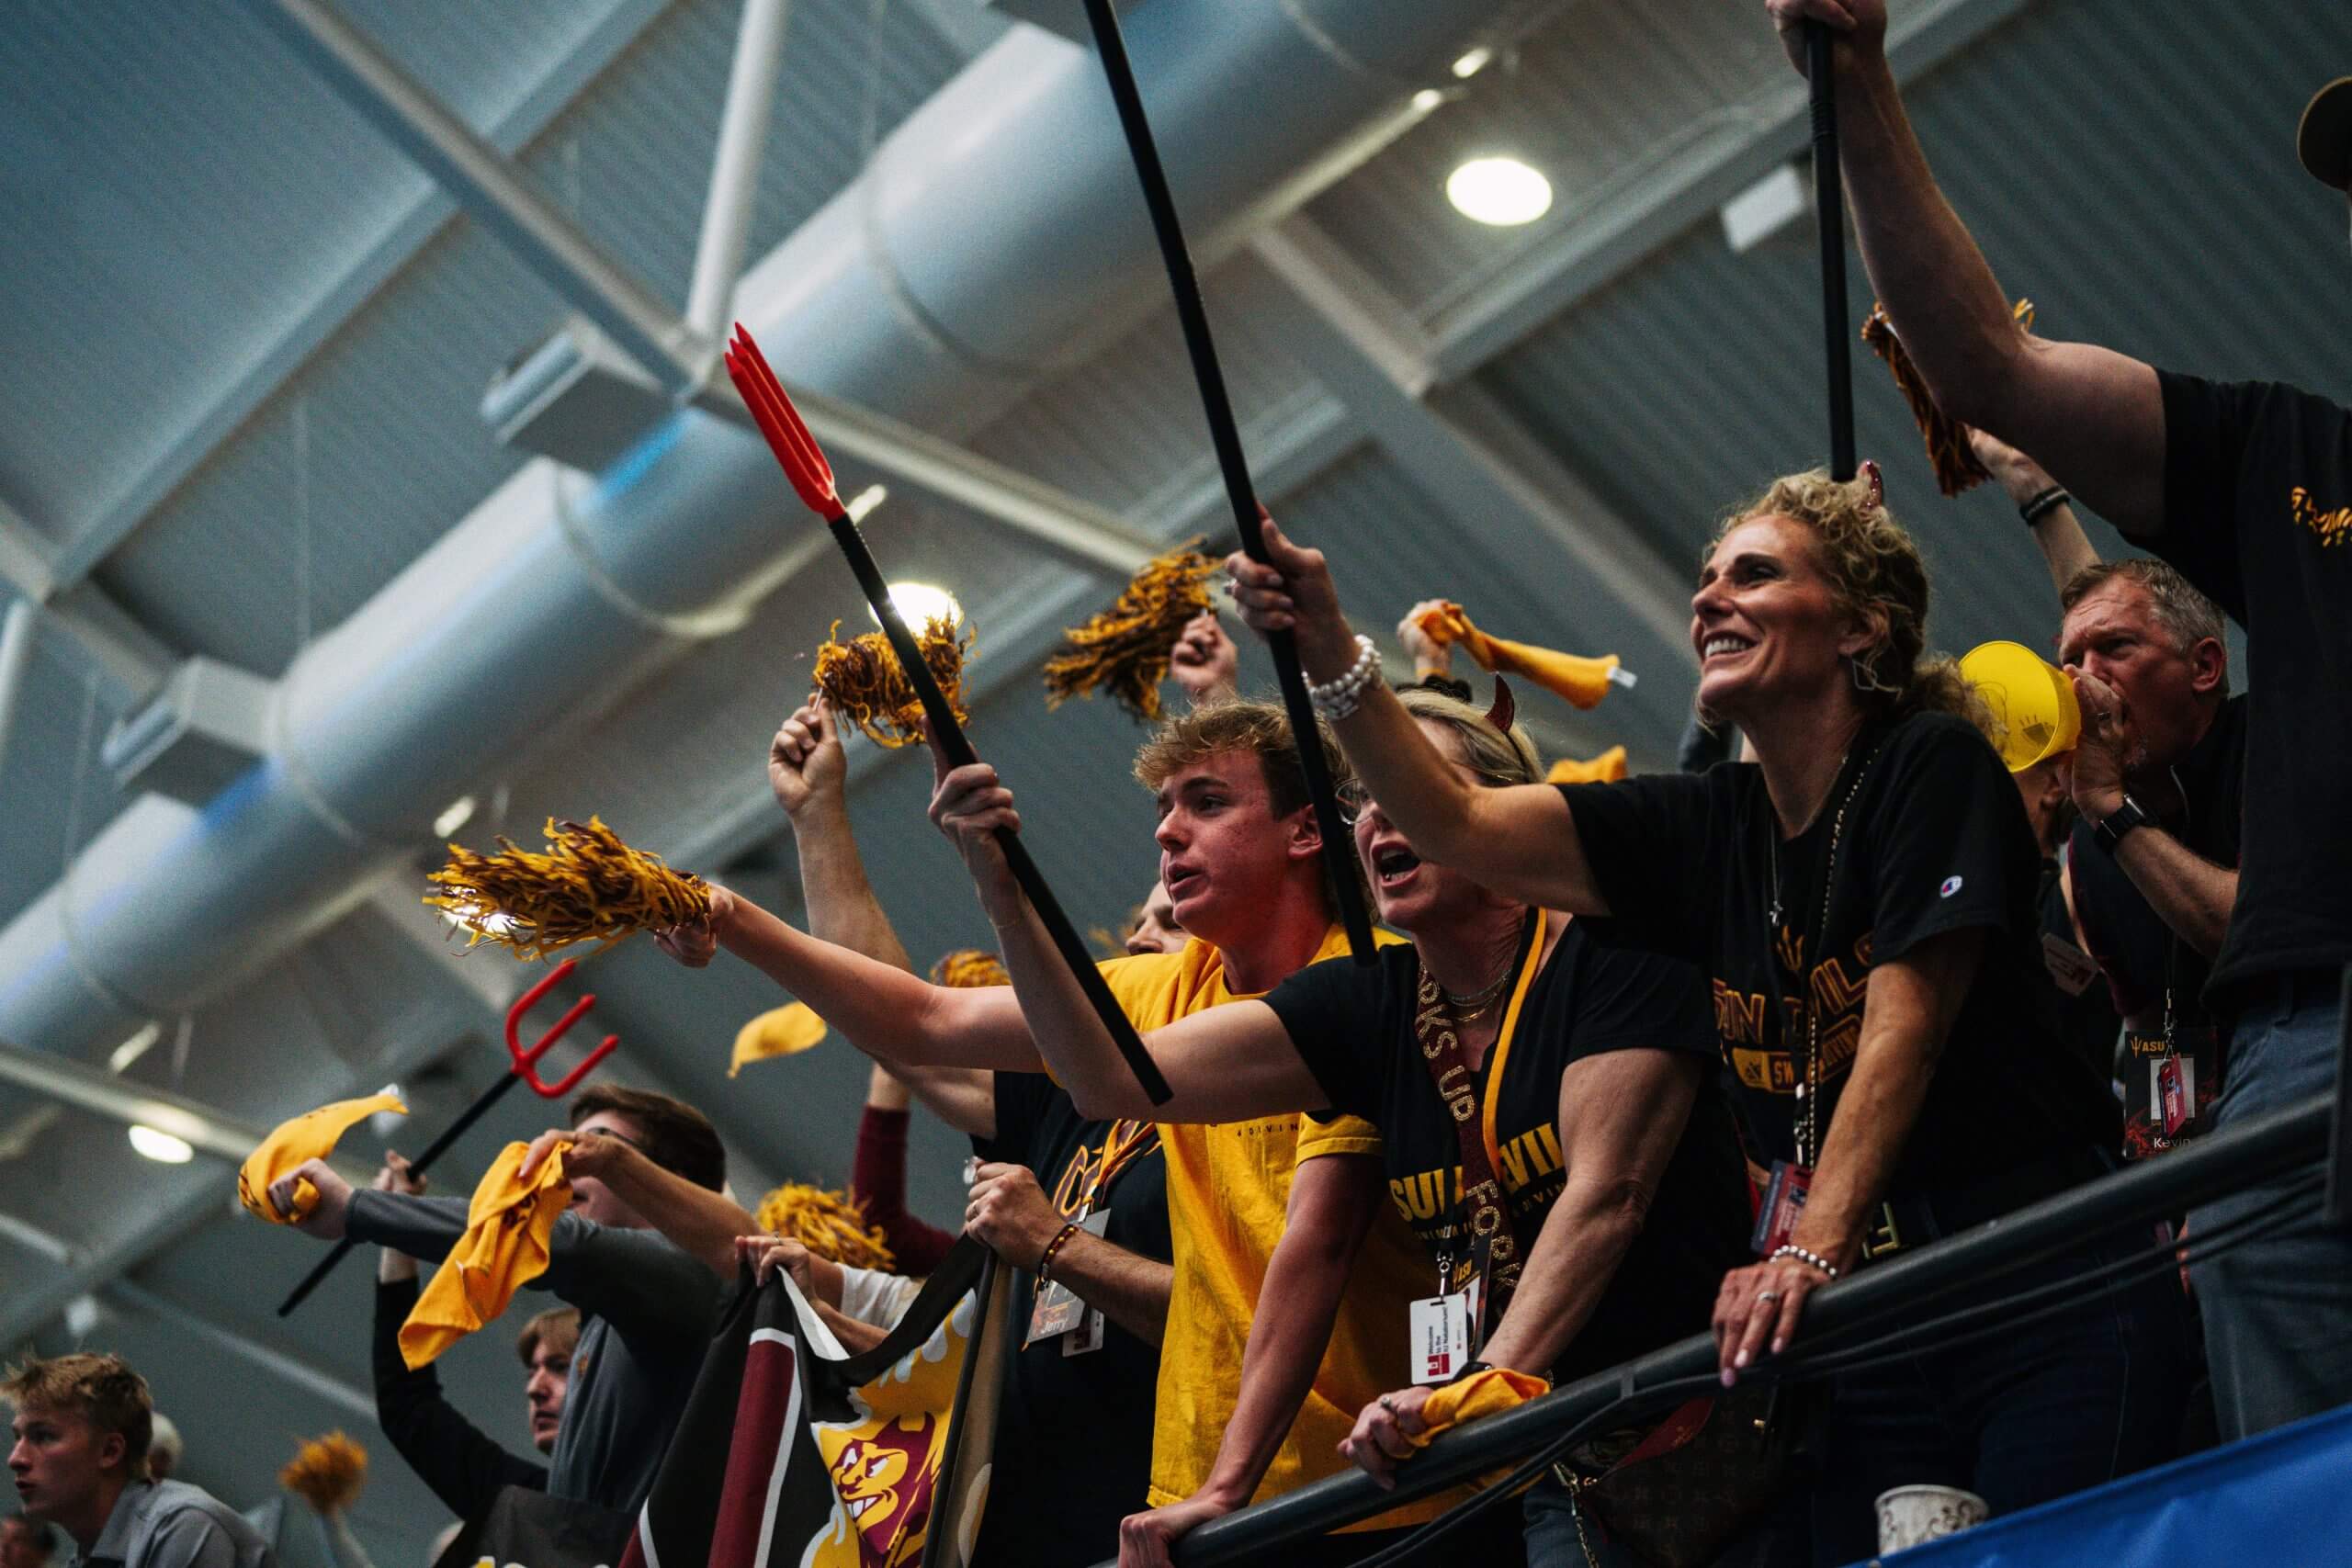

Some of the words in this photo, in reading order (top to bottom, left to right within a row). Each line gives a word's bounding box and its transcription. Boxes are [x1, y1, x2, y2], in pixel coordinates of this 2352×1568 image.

[2142, 1040, 2165, 1052] ASU
[1439, 1064, 1476, 1122] UP
[1249, 1123, 1299, 1135] DIVIN
